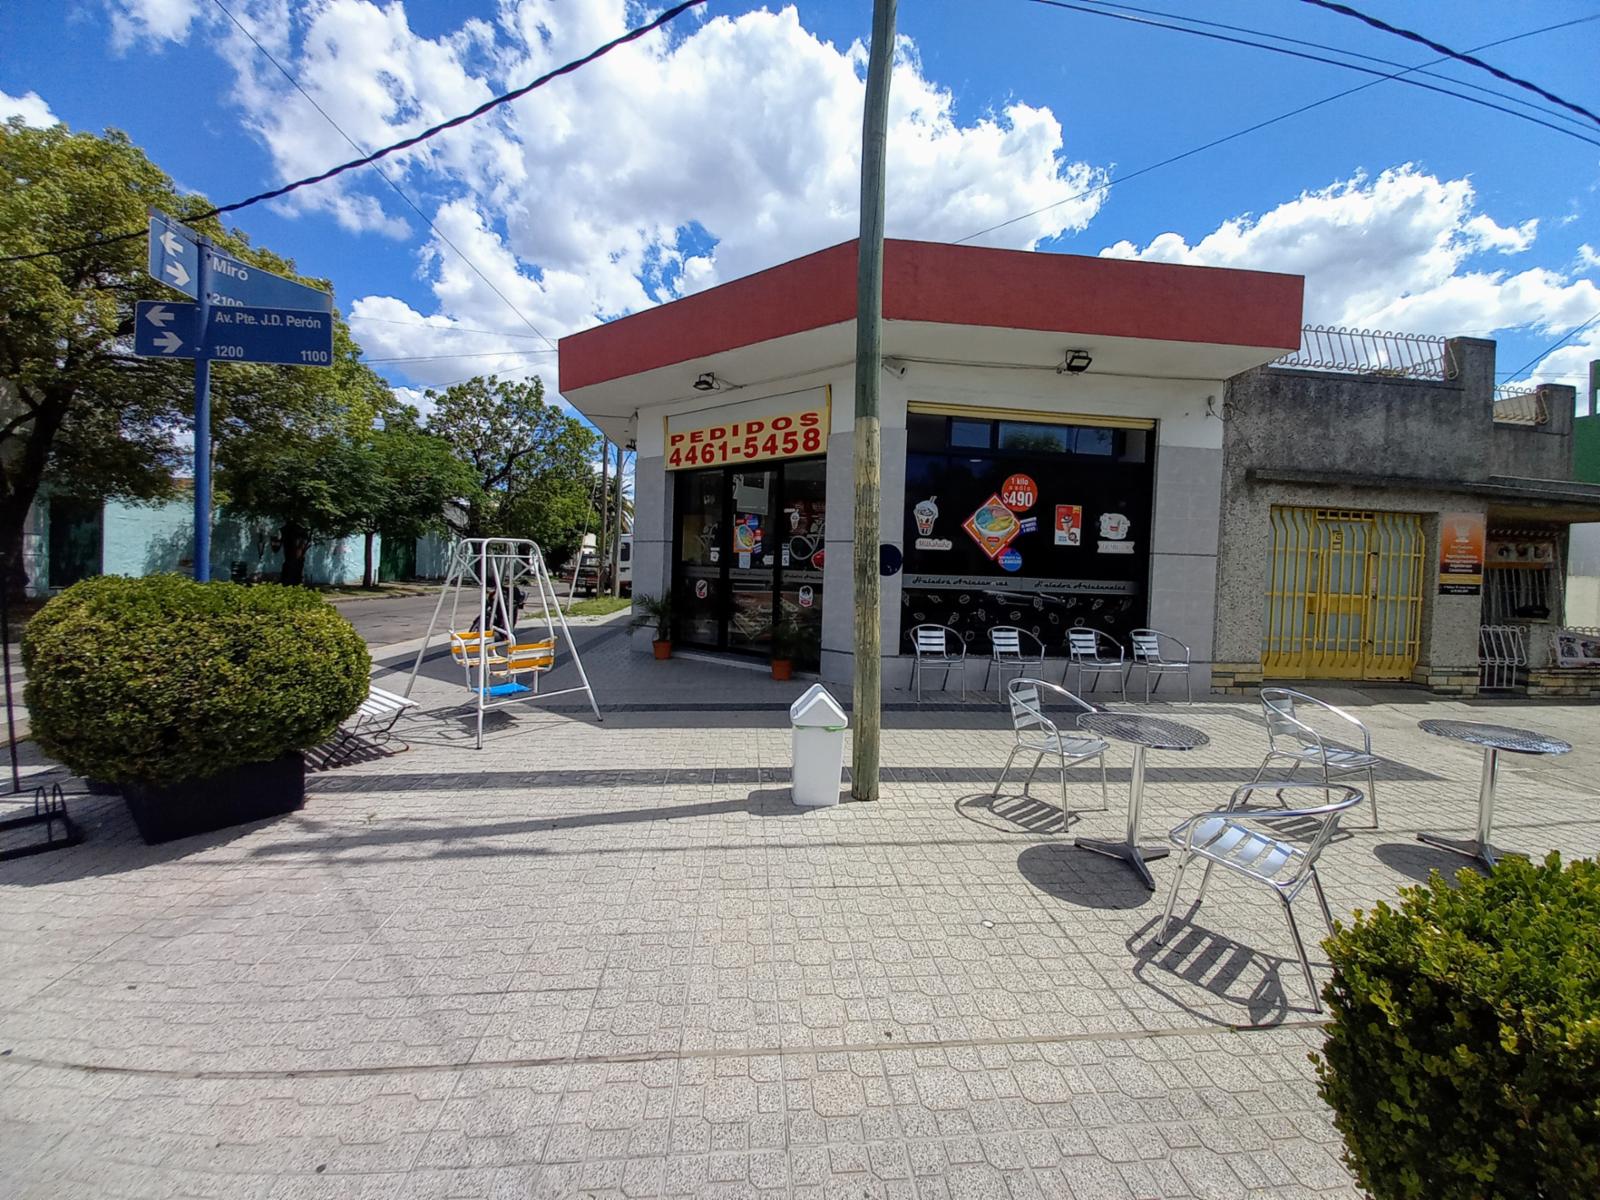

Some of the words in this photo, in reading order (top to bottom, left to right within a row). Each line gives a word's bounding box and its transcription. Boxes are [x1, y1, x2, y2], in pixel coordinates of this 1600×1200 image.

[213, 256, 249, 281] Miró
[215, 312, 233, 323] Av.
[236, 313, 258, 325] Pte.
[260, 314, 284, 326] J.D.
[286, 315, 321, 329] Perón
[214, 345, 244, 358] 1200
[300, 350, 328, 362] 1100
[670, 412, 820, 447] PEDIDOS
[669, 427, 821, 467] 4461-5458
[1003, 491, 1033, 507] $490
